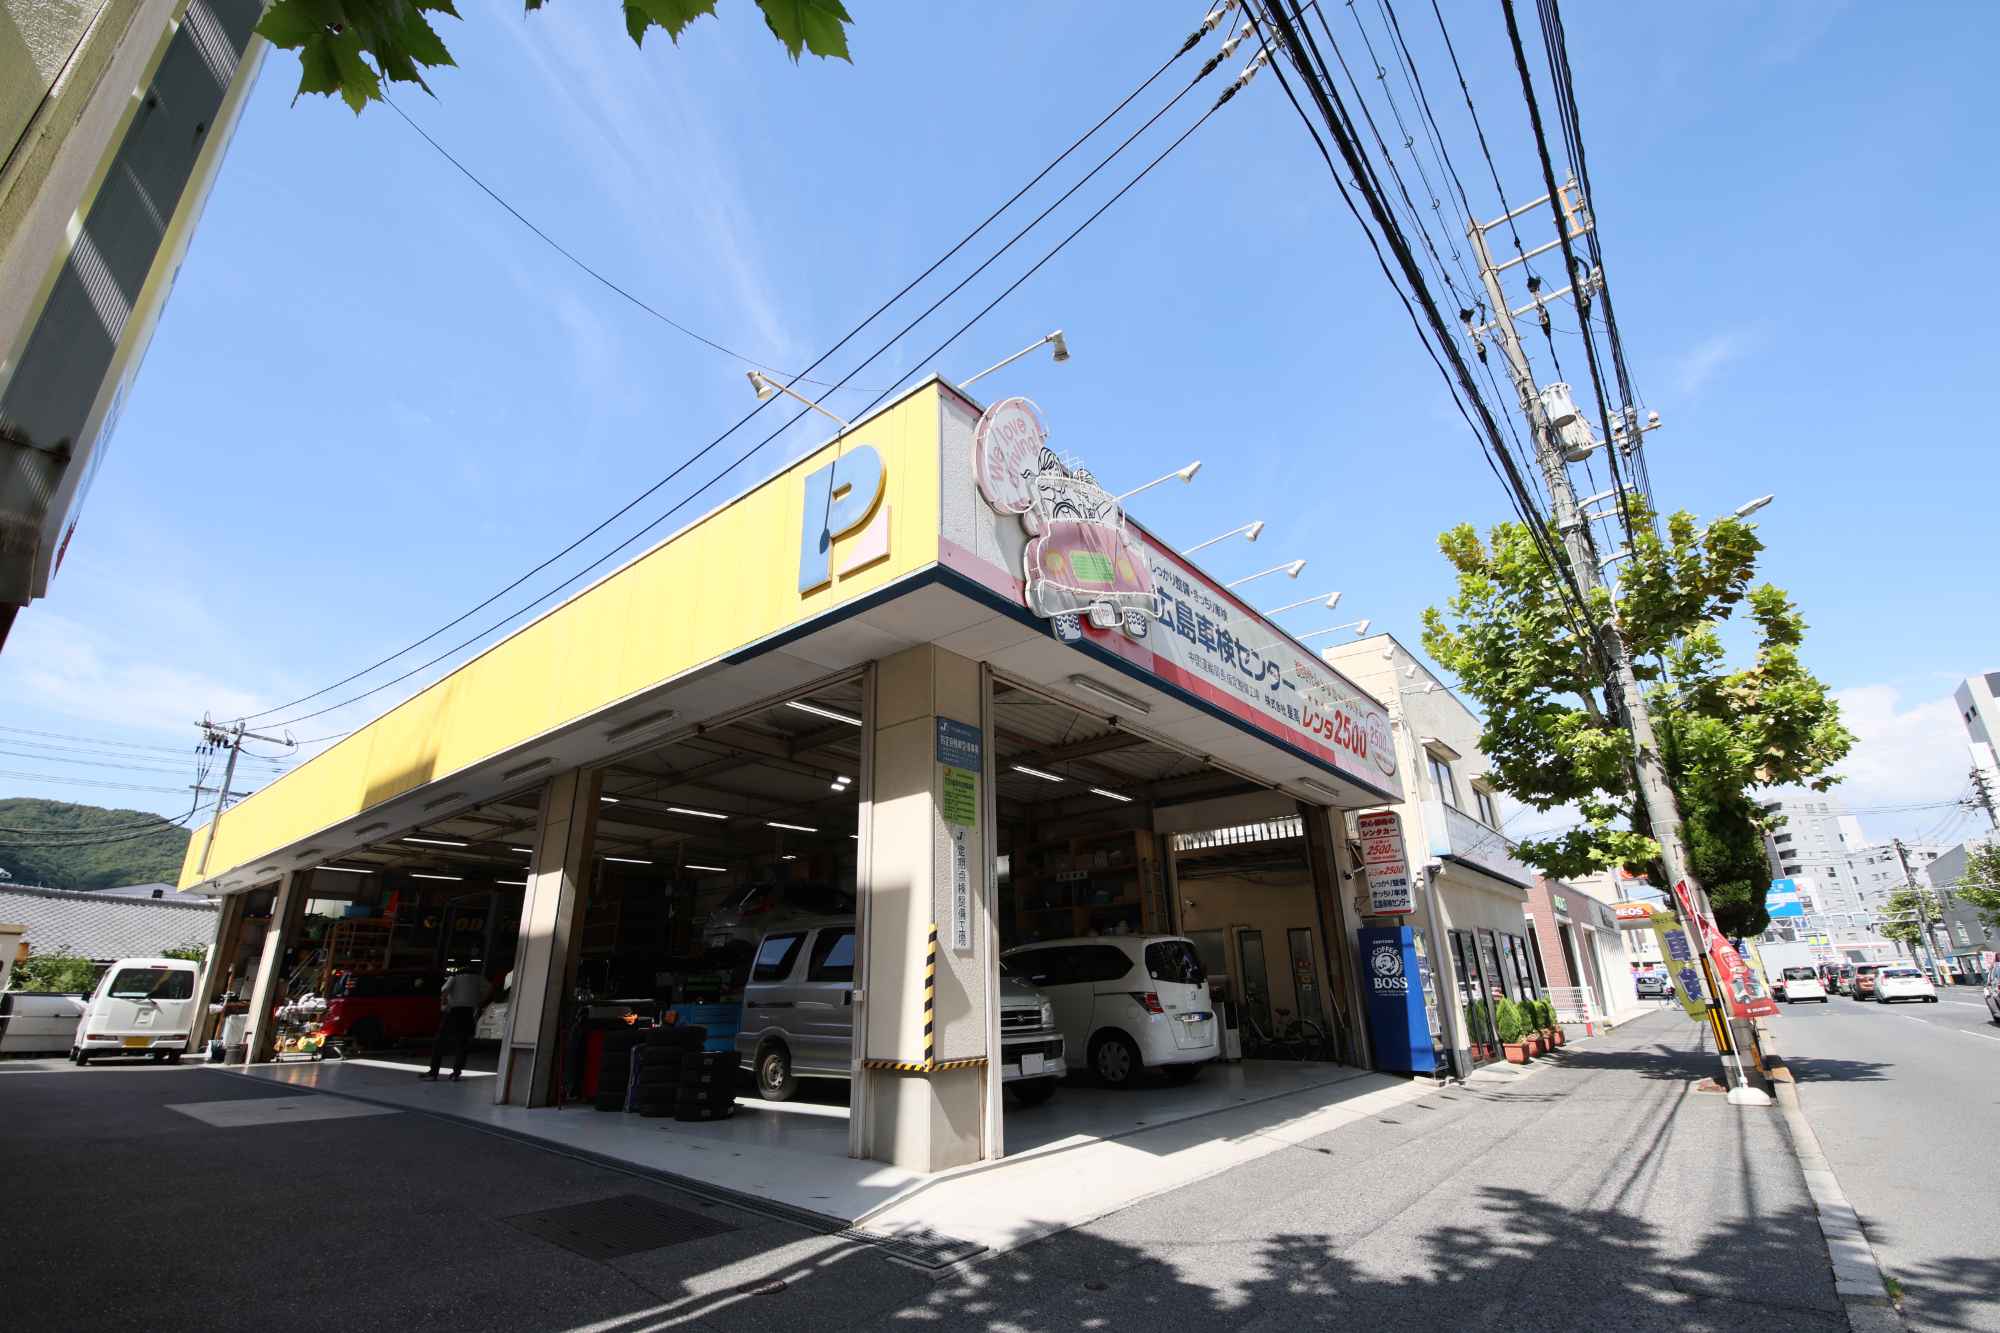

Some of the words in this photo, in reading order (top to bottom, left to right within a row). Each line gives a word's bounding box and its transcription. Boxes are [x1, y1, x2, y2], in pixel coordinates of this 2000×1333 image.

[1153, 585, 1297, 691] 広島車検センター
[1302, 708, 1368, 759] レンタ2500
[1362, 829, 1397, 837] レンタカー
[1372, 945, 1398, 956] COFFEE
[1373, 977, 1408, 990] BOSS
